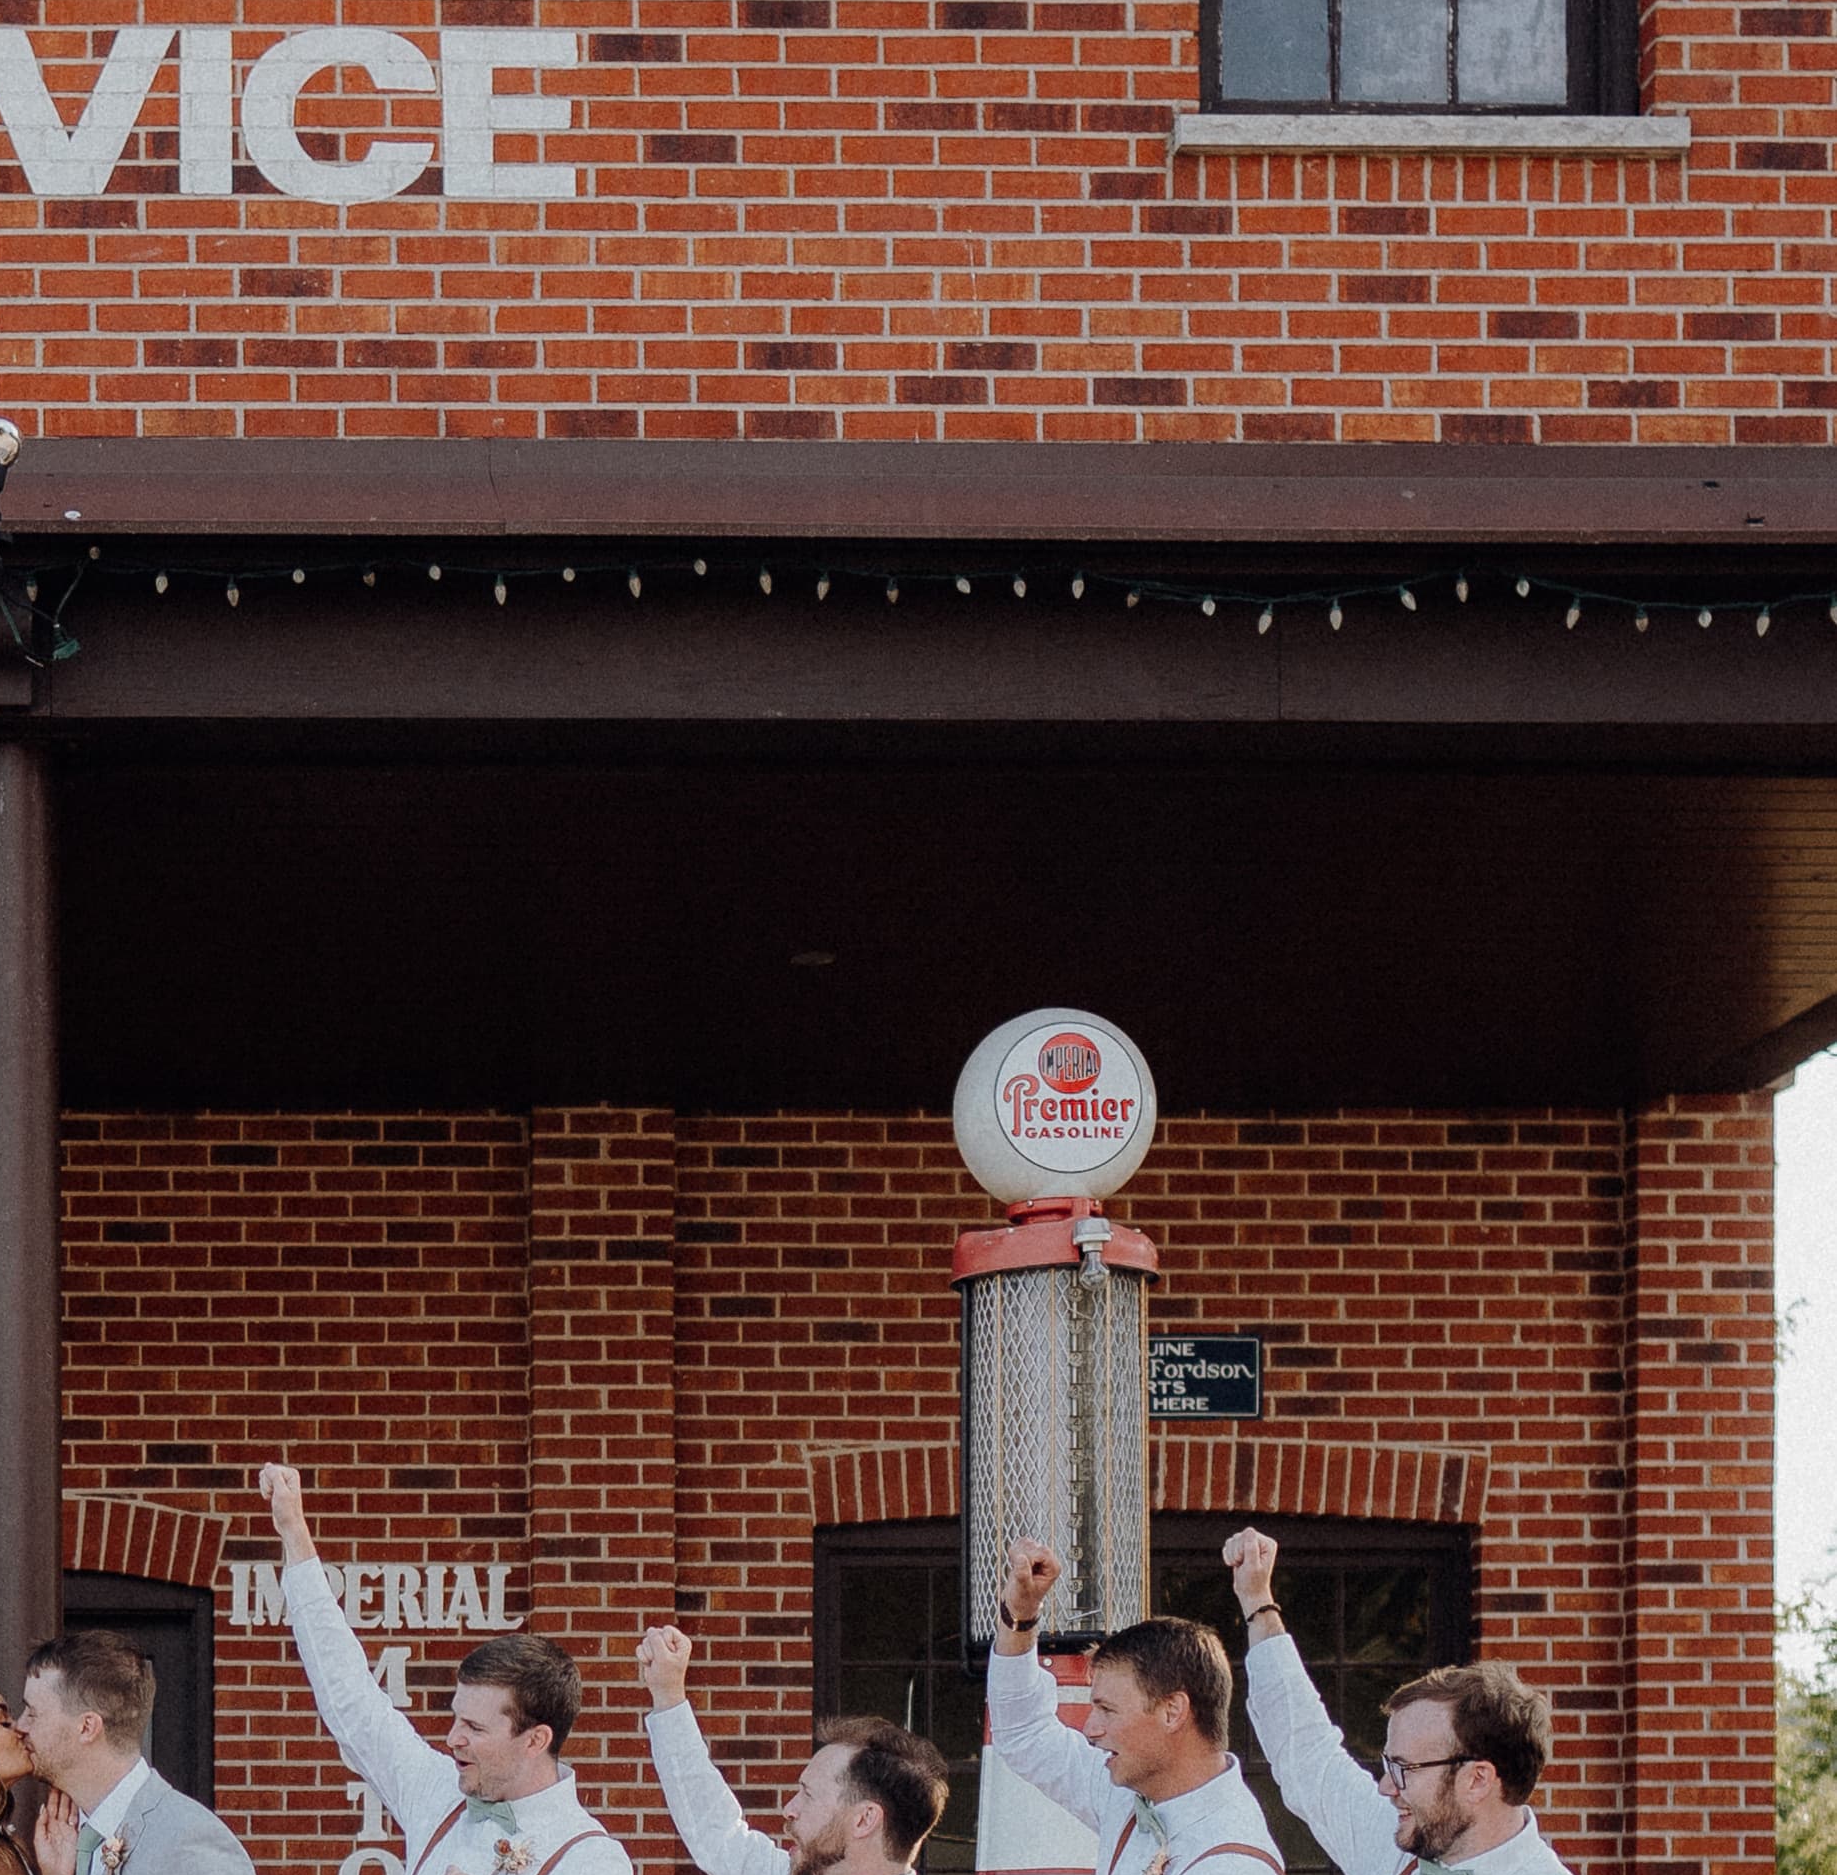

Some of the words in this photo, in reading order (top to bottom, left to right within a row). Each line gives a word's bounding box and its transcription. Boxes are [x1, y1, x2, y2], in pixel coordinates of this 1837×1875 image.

[1041, 1045, 1100, 1081] IMPERIAL
[1003, 1073, 1135, 1137] Premier
[1025, 1127, 1124, 1139] GASOLINE
[1148, 1342, 1196, 1357] UINE
[1150, 1358, 1256, 1379] Fordson
[1148, 1380, 1187, 1395] RTS
[1152, 1397, 1210, 1412] HERE
